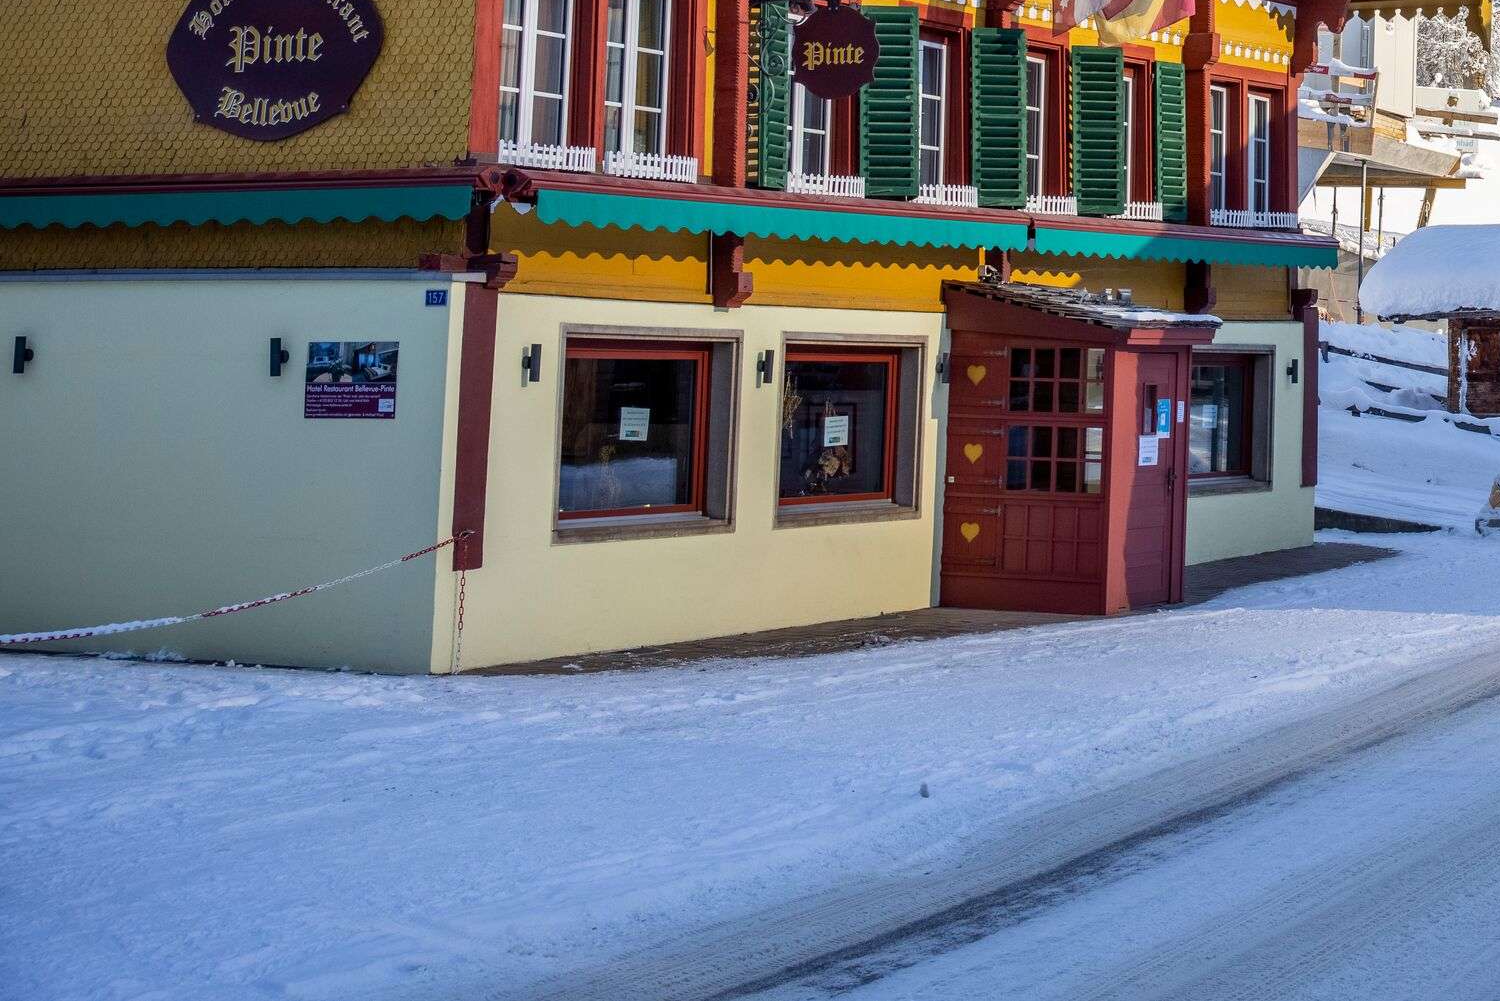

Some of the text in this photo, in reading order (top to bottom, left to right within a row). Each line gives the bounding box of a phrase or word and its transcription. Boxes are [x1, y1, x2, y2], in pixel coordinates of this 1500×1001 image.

[225, 25, 324, 73] Pinte
[802, 41, 865, 71] Pinte
[214, 86, 321, 126] Bellevue
[428, 292, 443, 304] 157
